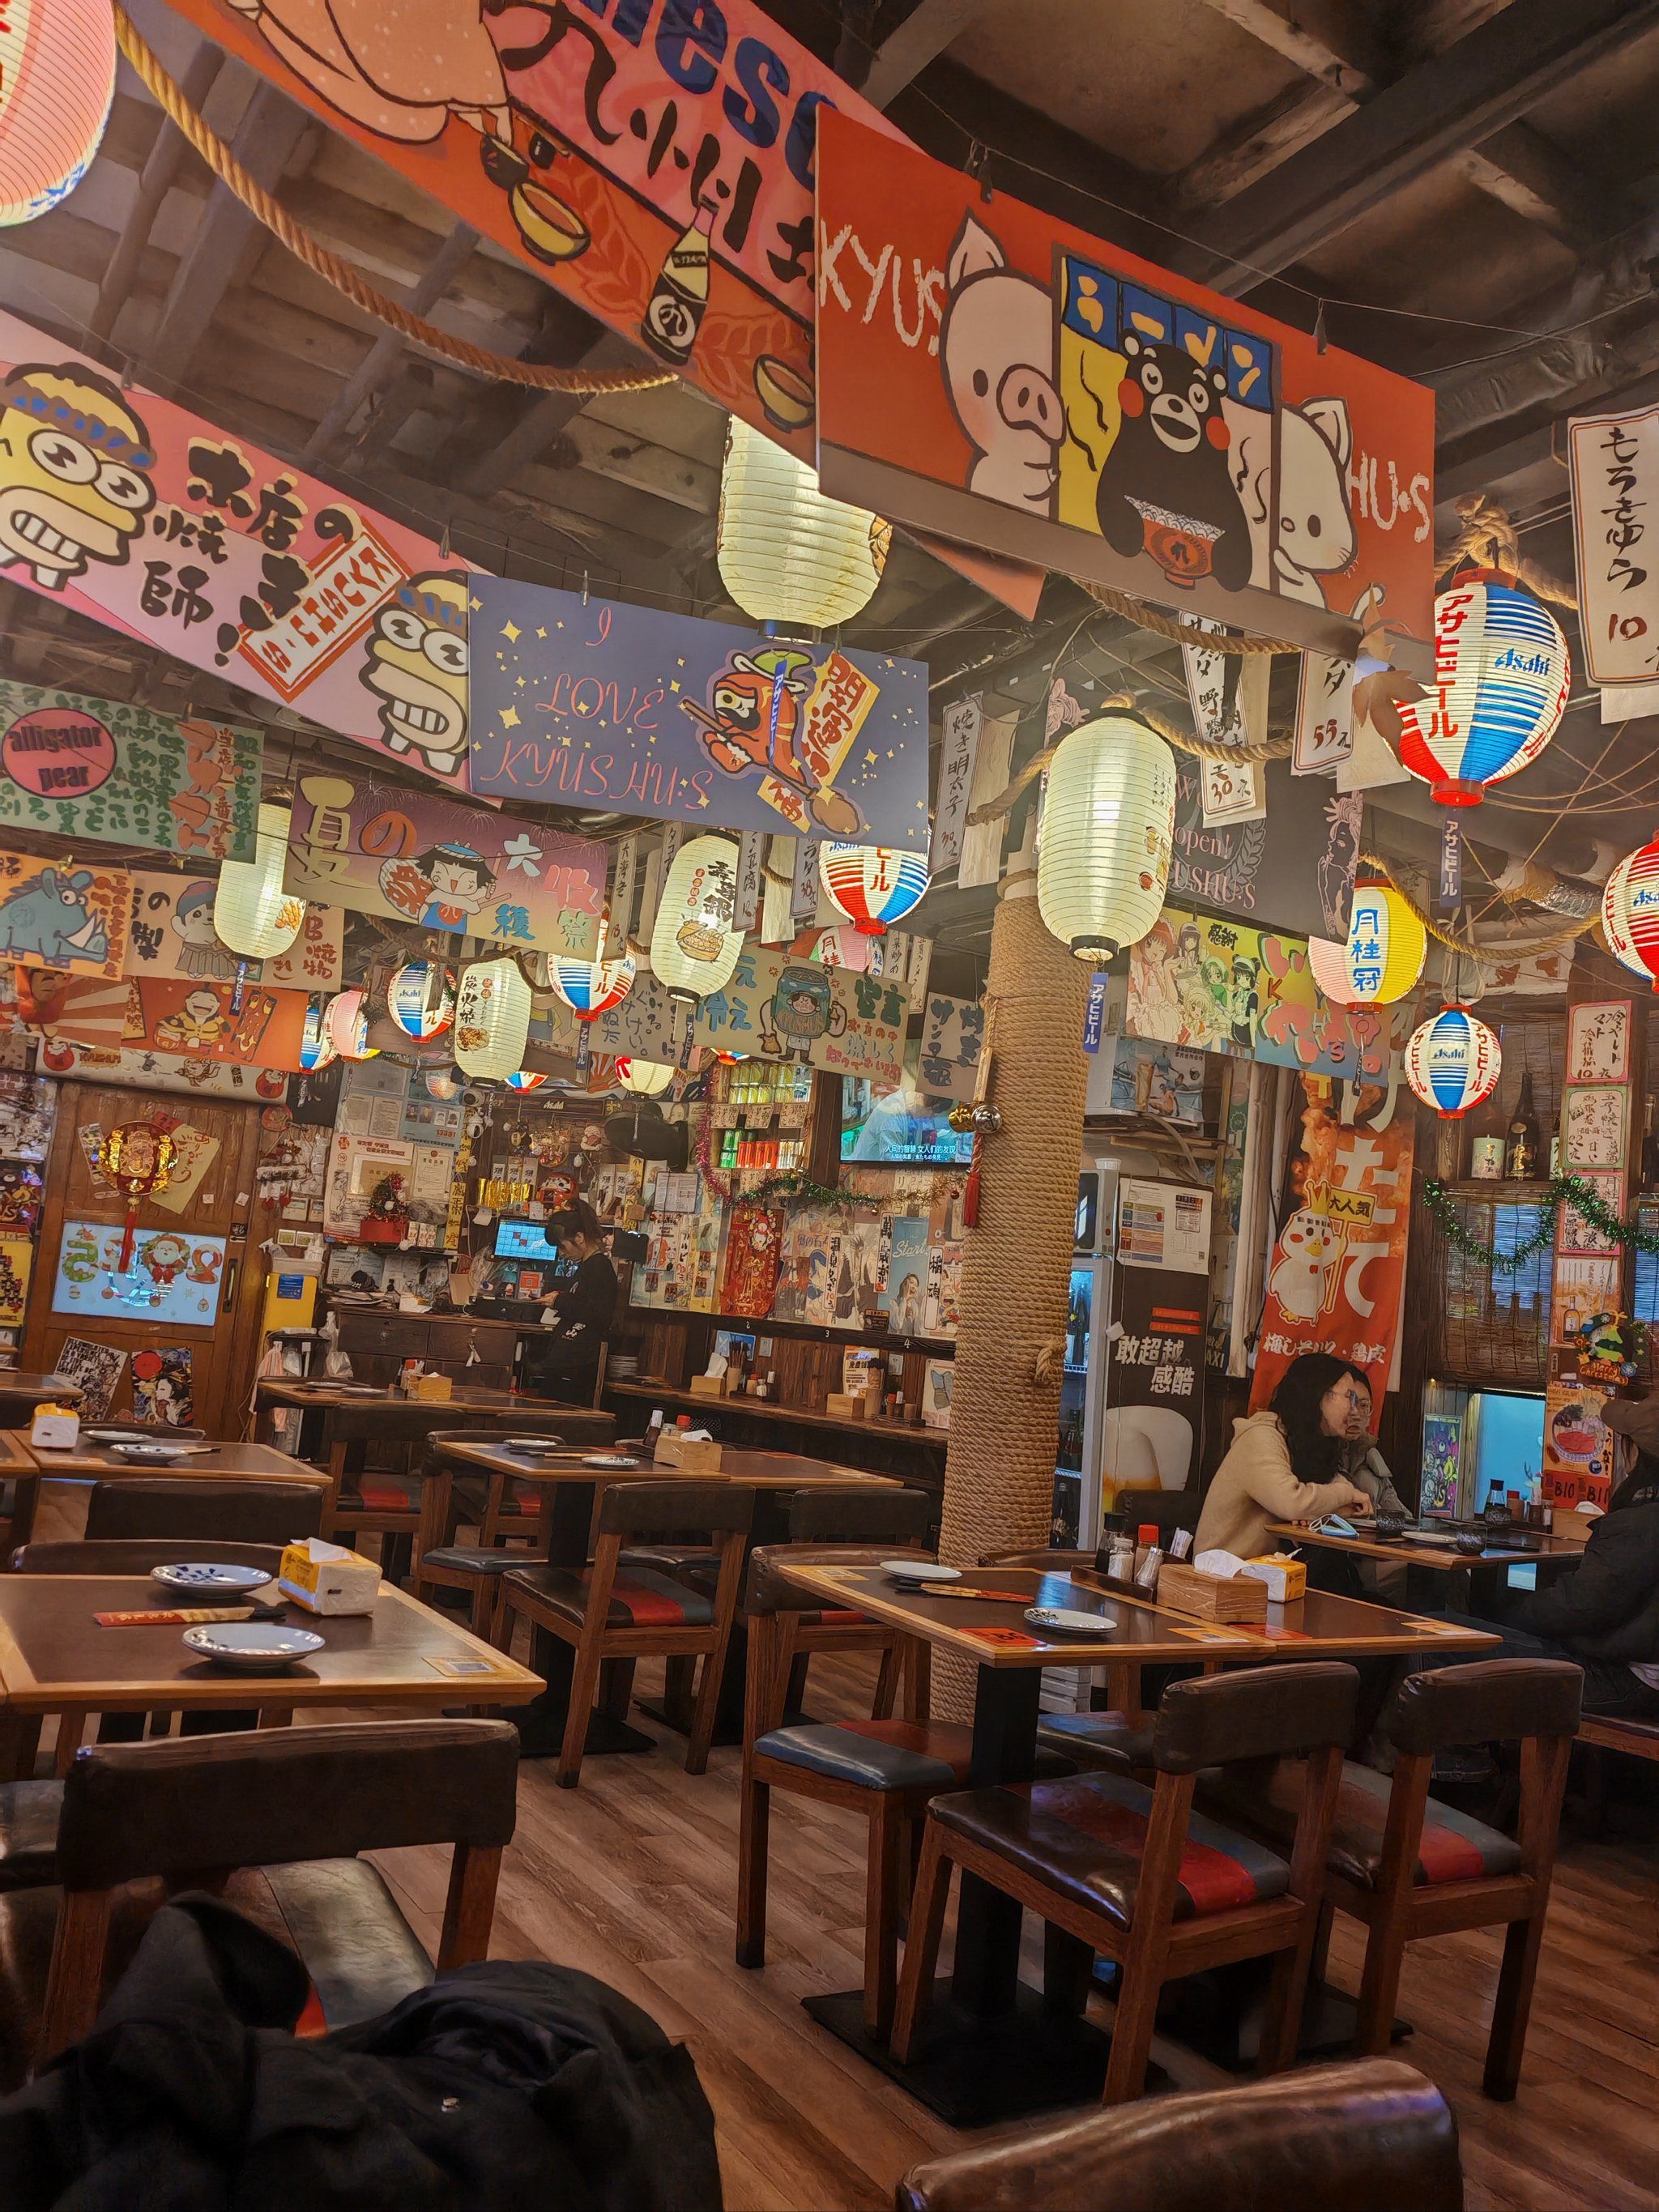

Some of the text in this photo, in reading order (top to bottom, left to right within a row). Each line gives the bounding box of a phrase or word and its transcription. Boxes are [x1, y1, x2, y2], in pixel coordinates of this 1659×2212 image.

[1427, 592, 1474, 738] アサヒビール
[1495, 647, 1550, 677] Asahi
[535, 673, 665, 729] LOVE
[7, 723, 102, 753] alligator
[38, 765, 90, 792] pear
[945, 709, 975, 817] 焼き明太子
[1175, 826, 1232, 861] open!
[1350, 908, 1382, 993] 月桂冠
[1085, 983, 1105, 1046] アサヒビール
[1433, 1048, 1465, 1060] Asahi
[544, 1100, 565, 1110] Asahi
[1328, 1194, 1371, 1218] 大人気
[1115, 1336, 1185, 1367] 敢超越
[1149, 1364, 1196, 1397] 感酷
